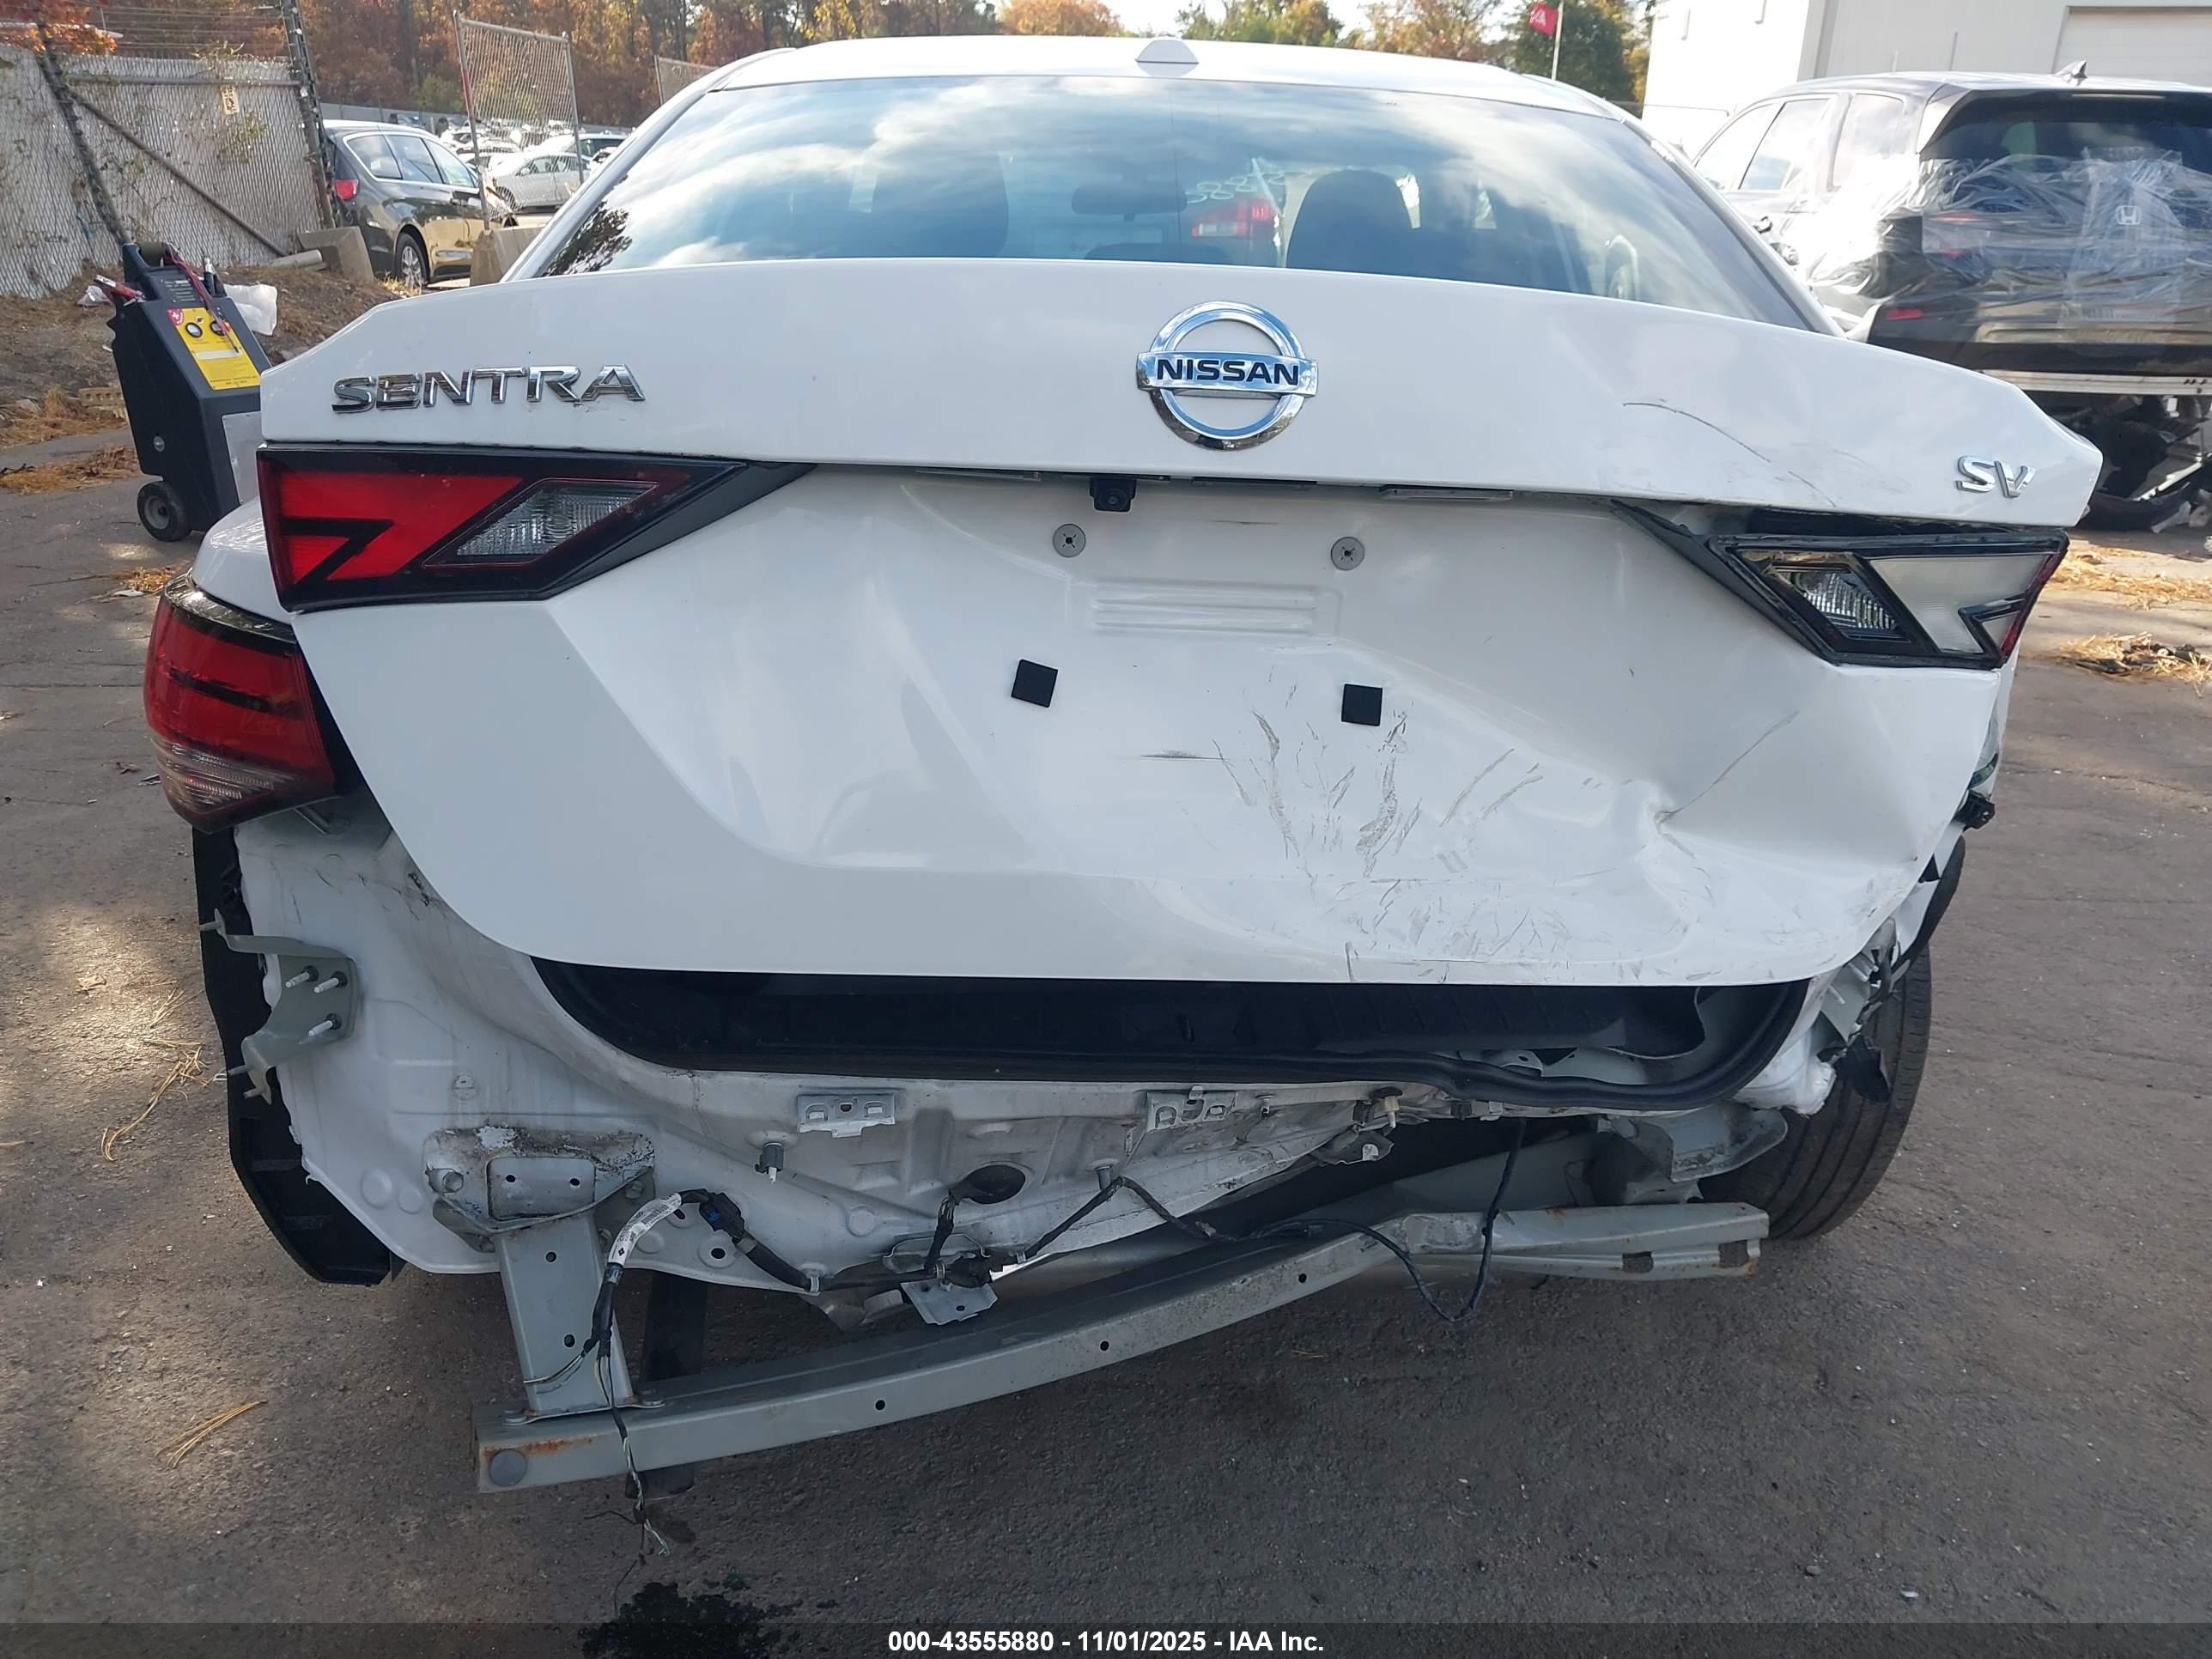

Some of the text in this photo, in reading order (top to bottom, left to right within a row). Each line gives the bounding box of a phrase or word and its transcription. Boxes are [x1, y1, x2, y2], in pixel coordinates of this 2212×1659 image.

[331, 363, 646, 413] SENTRA
[1157, 359, 1299, 386] NISSAN
[1955, 454, 2036, 499] SV
